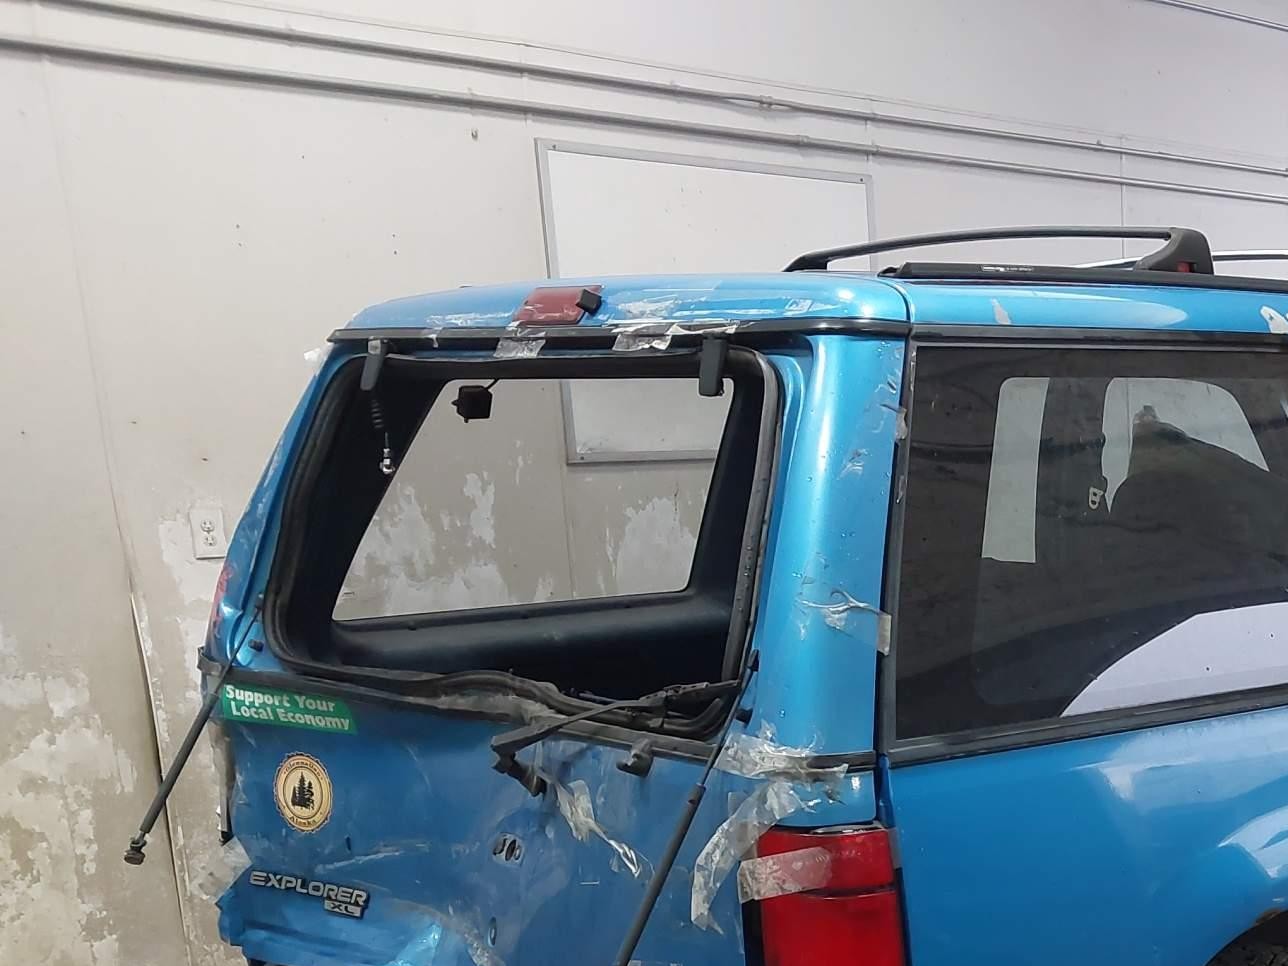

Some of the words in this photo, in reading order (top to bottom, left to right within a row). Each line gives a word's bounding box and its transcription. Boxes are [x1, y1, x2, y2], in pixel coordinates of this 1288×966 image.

[224, 684, 290, 707] Support
[294, 695, 336, 712] Your
[230, 700, 274, 720] Local
[276, 708, 350, 730] Economy
[250, 871, 368, 905] EXPLORER
